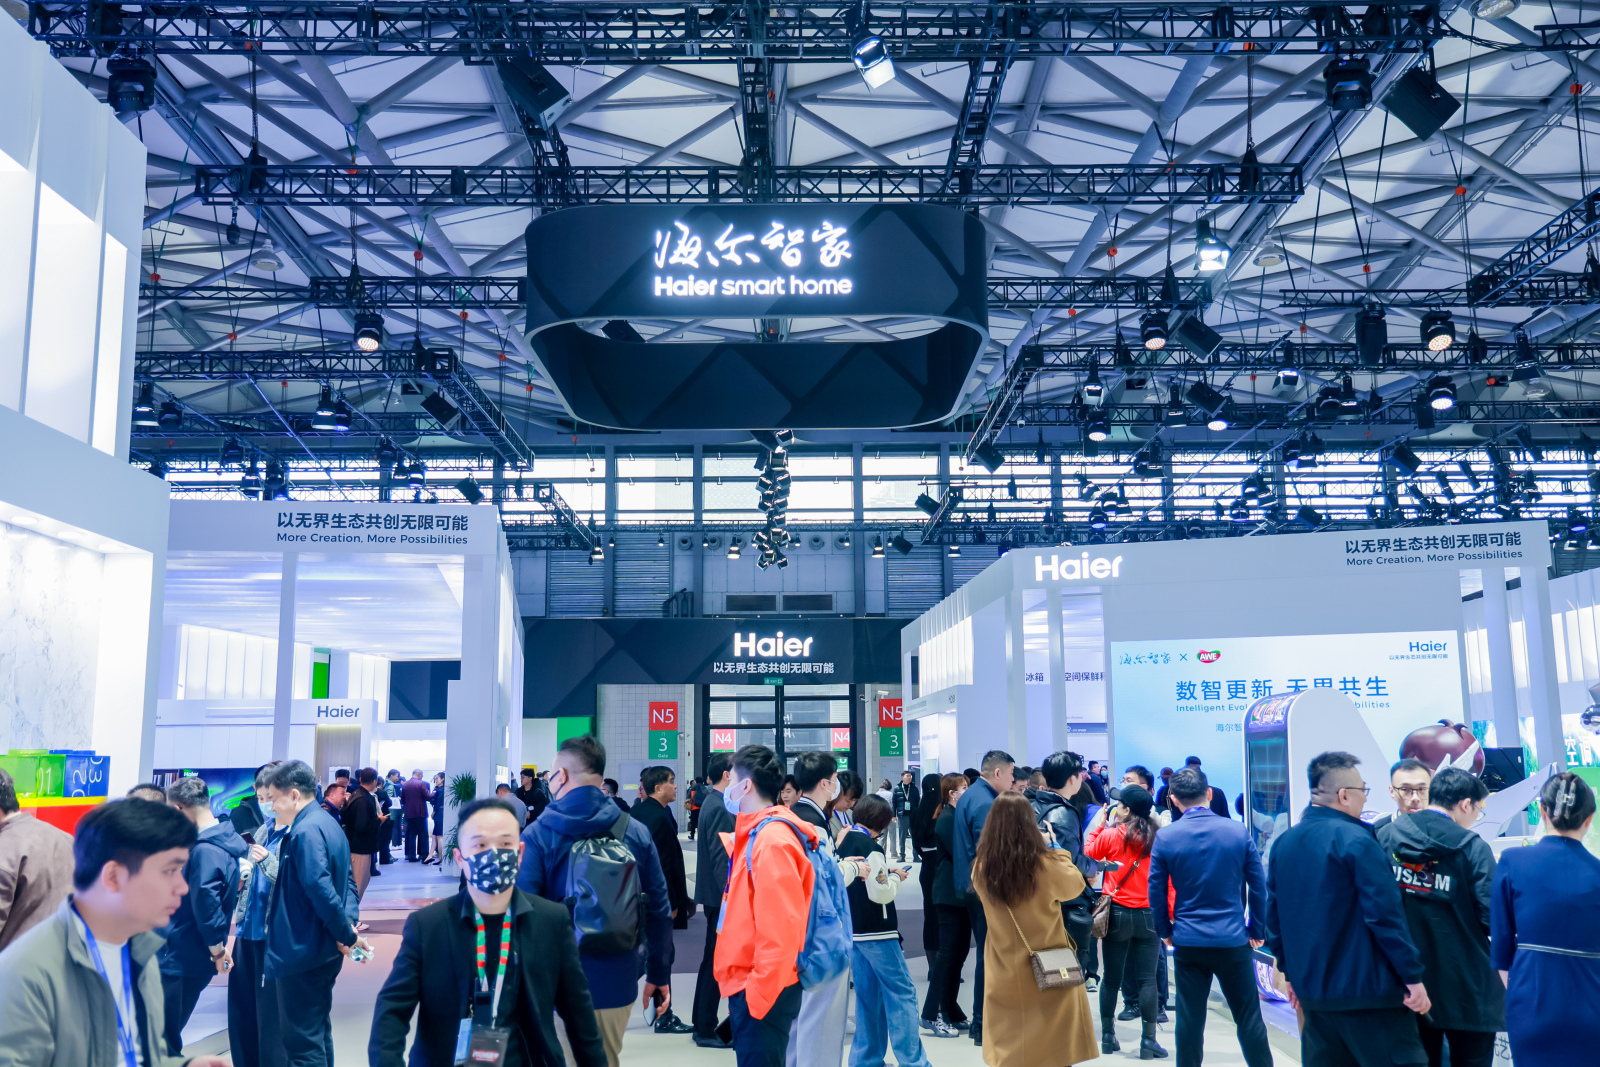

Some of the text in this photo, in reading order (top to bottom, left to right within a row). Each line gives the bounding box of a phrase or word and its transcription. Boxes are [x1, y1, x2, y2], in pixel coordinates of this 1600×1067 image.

[654, 219, 852, 269] 海尔智家
[654, 274, 853, 296] Haier smart home
[276, 512, 469, 531] 以无界生态共创无限可能
[276, 533, 468, 544] More Creation, More Possibilities
[1345, 531, 1522, 554] 以无界生态共创无限可能
[1346, 550, 1523, 566] More Creation, More Possibilities
[1034, 551, 1123, 582] Haier
[733, 631, 814, 657] Haier
[1409, 641, 1447, 652] Haier
[713, 662, 834, 674] 以无界生态共创无限可能
[1175, 679, 1273, 701] 数智更新
[317, 705, 360, 718] Haier
[882, 706, 903, 720] N5
[1176, 704, 1226, 713] Intelligent
[652, 708, 675, 724] N5
[715, 733, 732, 744] N4
[834, 731, 850, 743] N4
[890, 735, 899, 749] 3
[659, 738, 668, 752] 3
